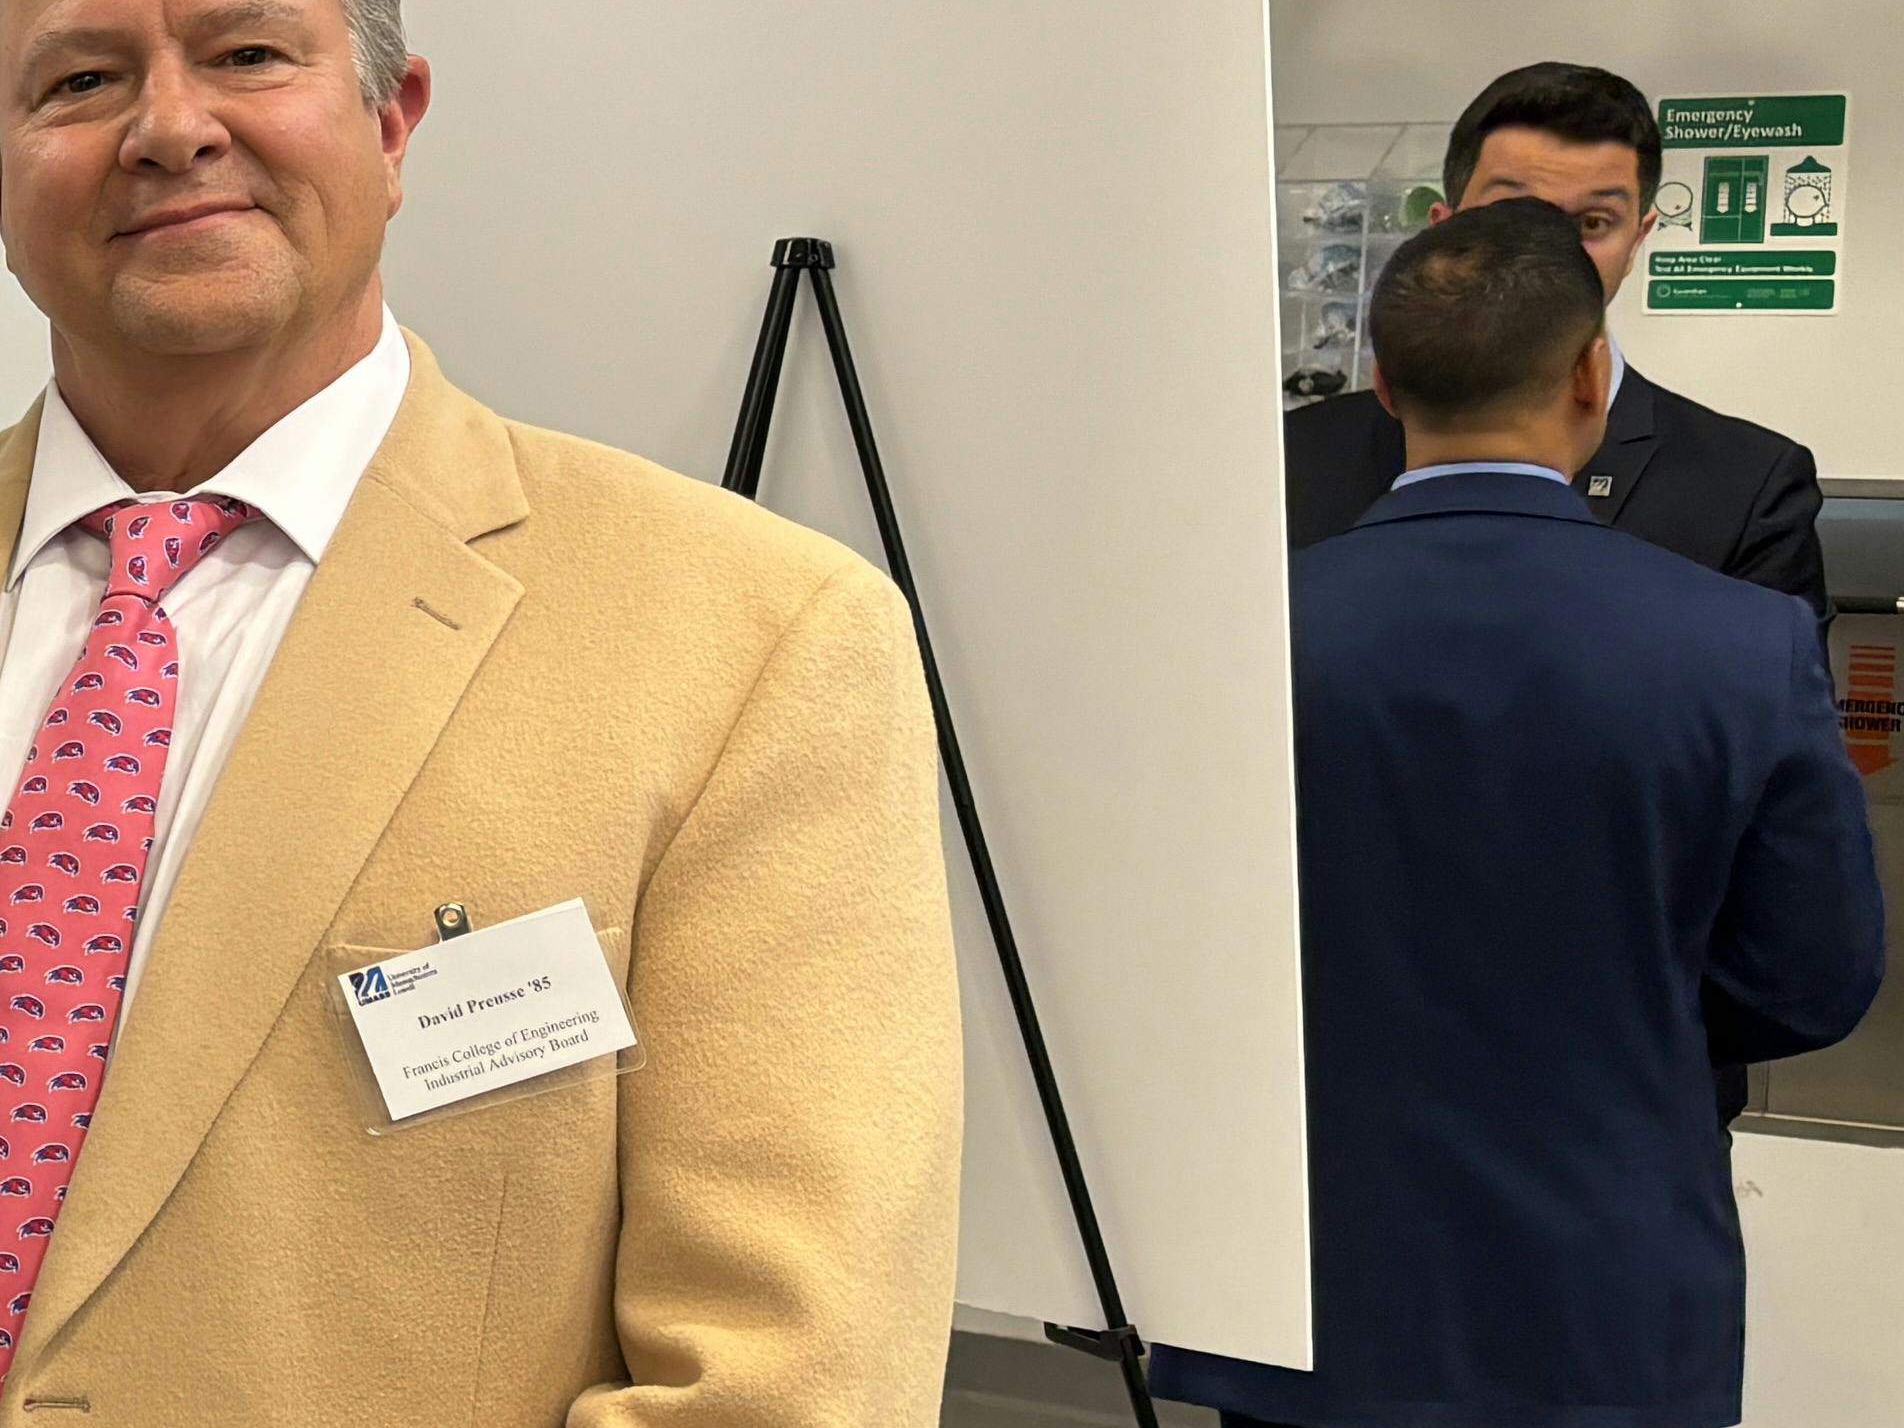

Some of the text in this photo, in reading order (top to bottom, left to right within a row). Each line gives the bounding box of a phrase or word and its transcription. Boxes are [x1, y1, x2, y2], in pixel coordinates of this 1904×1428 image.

[1664, 123, 1802, 140] Shower/Eyewash
[1666, 109, 1754, 123] Emergency
[417, 976, 552, 1029] David Preusse '85
[402, 1009, 599, 1079] Francis College of Engineering
[424, 1029, 590, 1091] Industrial Advisory Board
